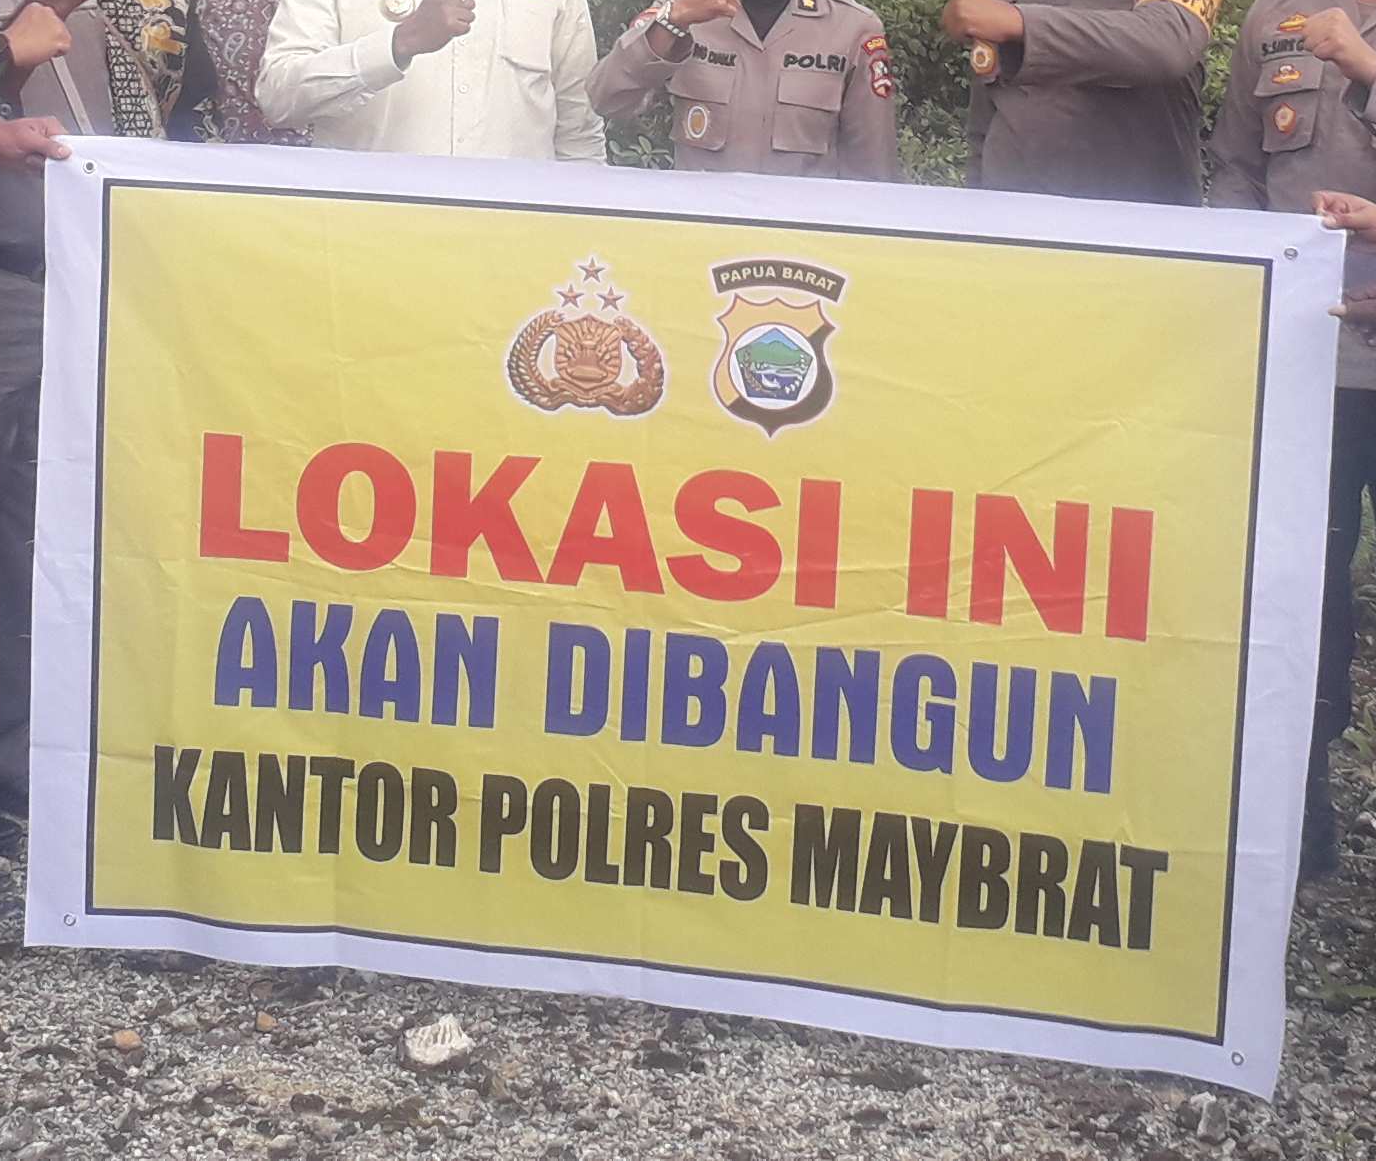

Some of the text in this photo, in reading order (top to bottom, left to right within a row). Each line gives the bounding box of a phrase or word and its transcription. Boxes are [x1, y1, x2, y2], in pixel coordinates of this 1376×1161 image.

[783, 53, 847, 72] POLRI
[720, 266, 837, 291] PAPUA BARAT
[199, 432, 1154, 640] LOKASI INI
[214, 596, 1118, 794] AKAN DIBANGUN
[152, 745, 1170, 952] KANTOR POLRES MAYBRAT
